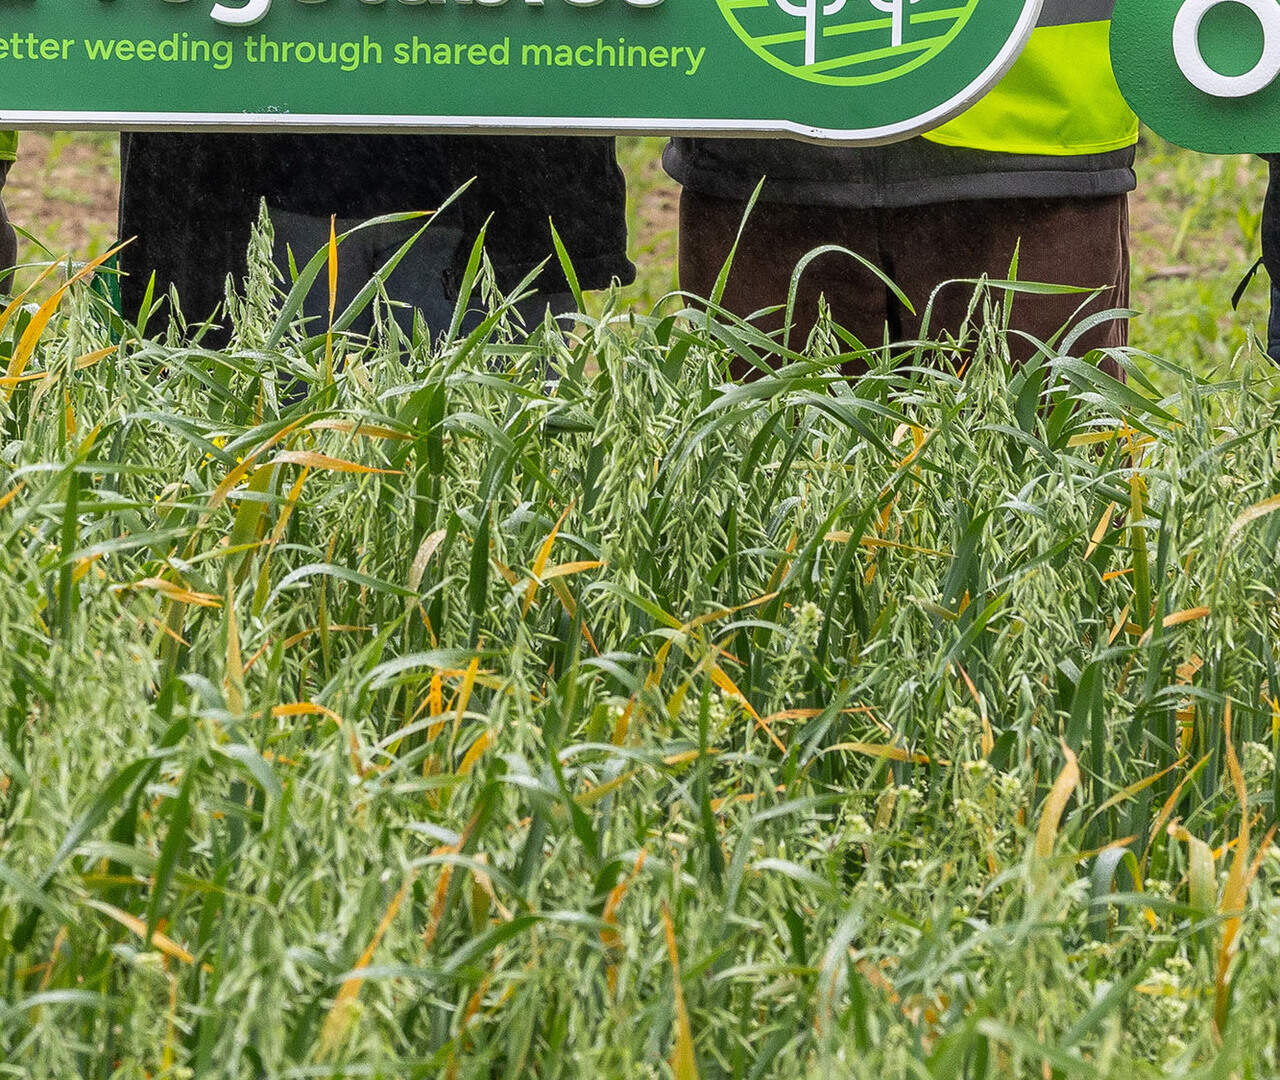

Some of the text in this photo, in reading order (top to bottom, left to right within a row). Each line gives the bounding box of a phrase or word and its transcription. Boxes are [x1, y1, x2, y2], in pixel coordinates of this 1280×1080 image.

[84, 32, 234, 70] weeding
[243, 35, 383, 73] through
[393, 36, 510, 66] shared
[521, 37, 707, 76] machinery
